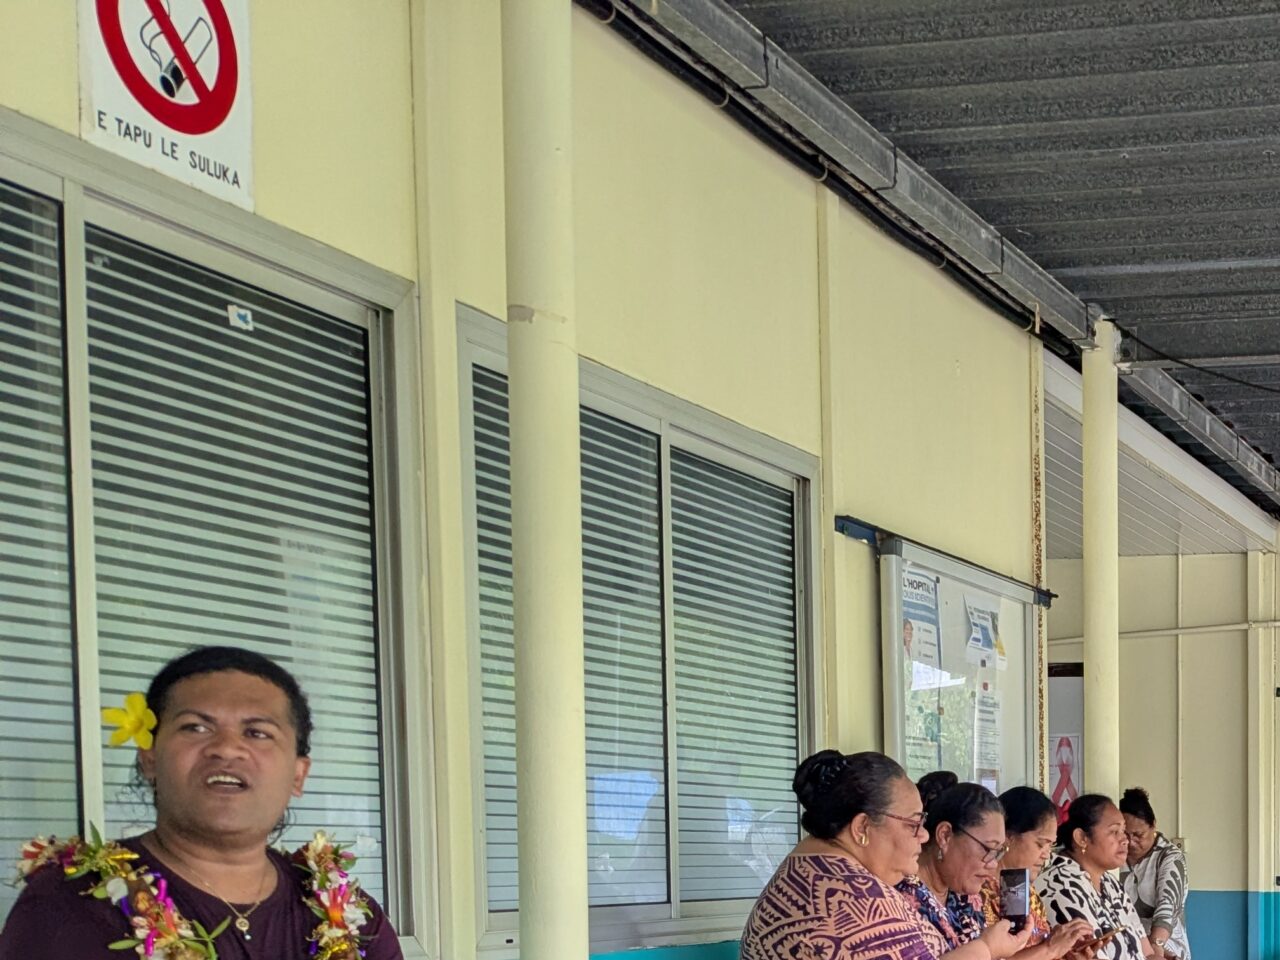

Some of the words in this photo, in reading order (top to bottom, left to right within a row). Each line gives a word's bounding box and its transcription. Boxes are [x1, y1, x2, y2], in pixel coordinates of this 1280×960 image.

[97, 110, 107, 130] E
[114, 117, 152, 149] TAPU
[161, 137, 178, 160] LE
[188, 150, 241, 189] SULUKA
